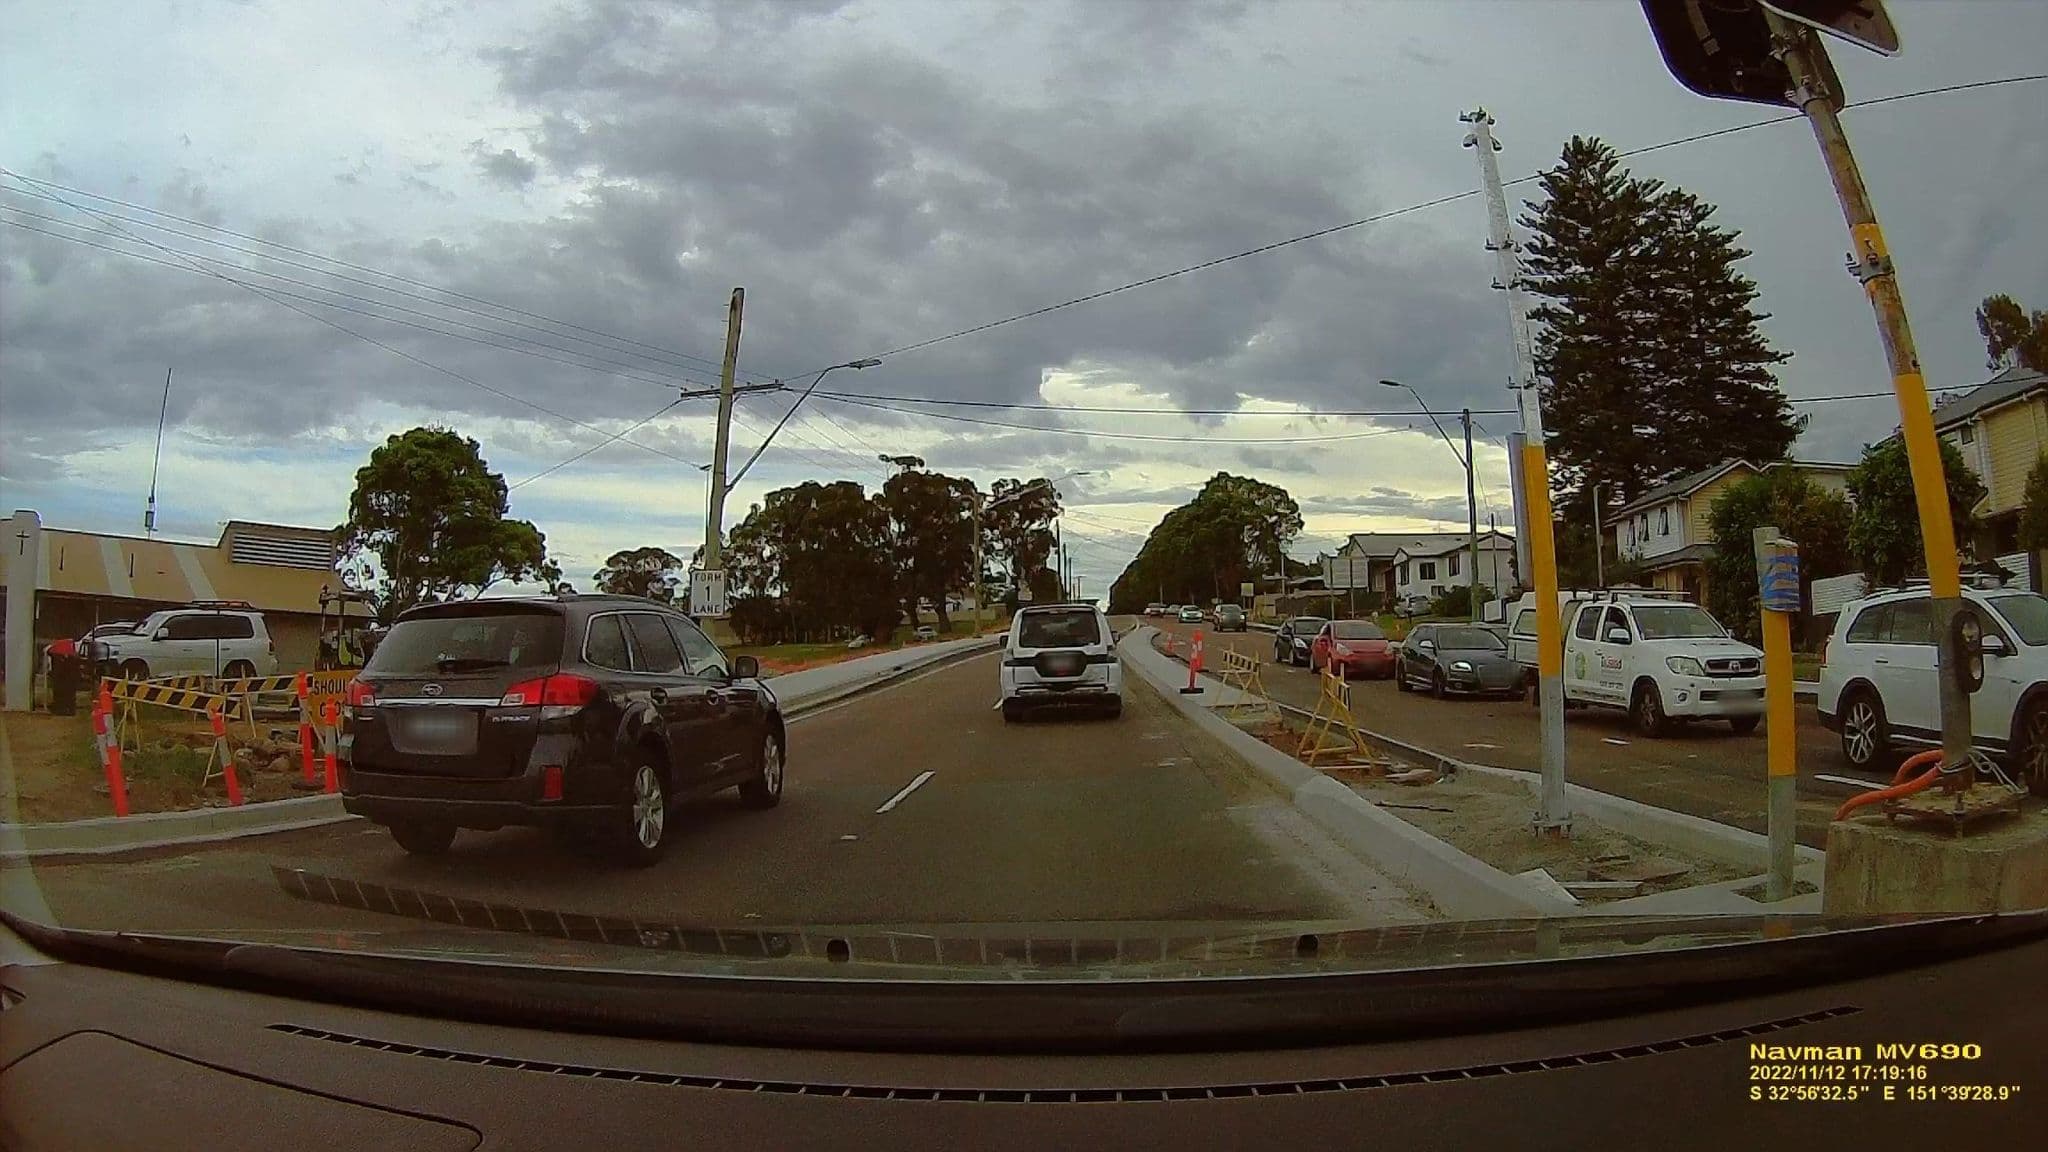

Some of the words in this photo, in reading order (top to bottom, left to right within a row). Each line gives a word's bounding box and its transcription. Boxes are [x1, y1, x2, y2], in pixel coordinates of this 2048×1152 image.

[695, 573, 721, 582] FORM
[704, 585, 711, 602] 1
[694, 604, 720, 613] LANE
